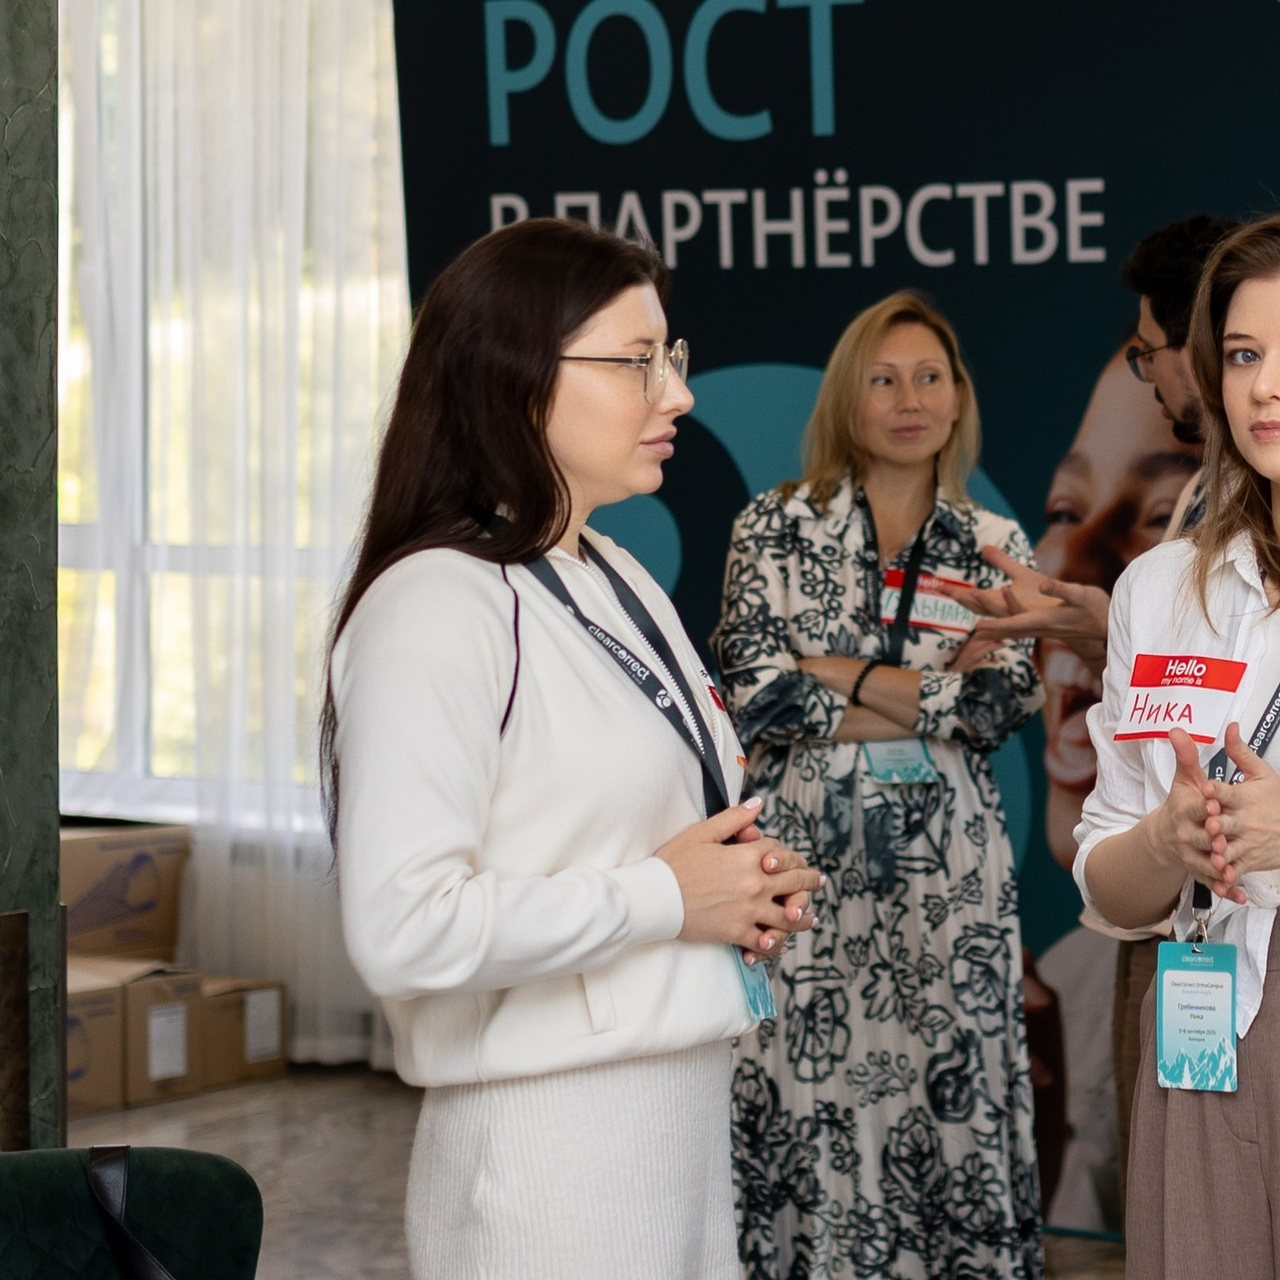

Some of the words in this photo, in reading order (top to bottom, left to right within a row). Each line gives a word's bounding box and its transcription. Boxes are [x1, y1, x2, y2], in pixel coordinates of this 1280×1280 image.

[587, 624, 650, 681] clearcorrect
[1165, 659, 1207, 677] Hello
[1160, 677, 1173, 686] my
[1172, 676, 1195, 685] name
[1195, 677, 1203, 686] is
